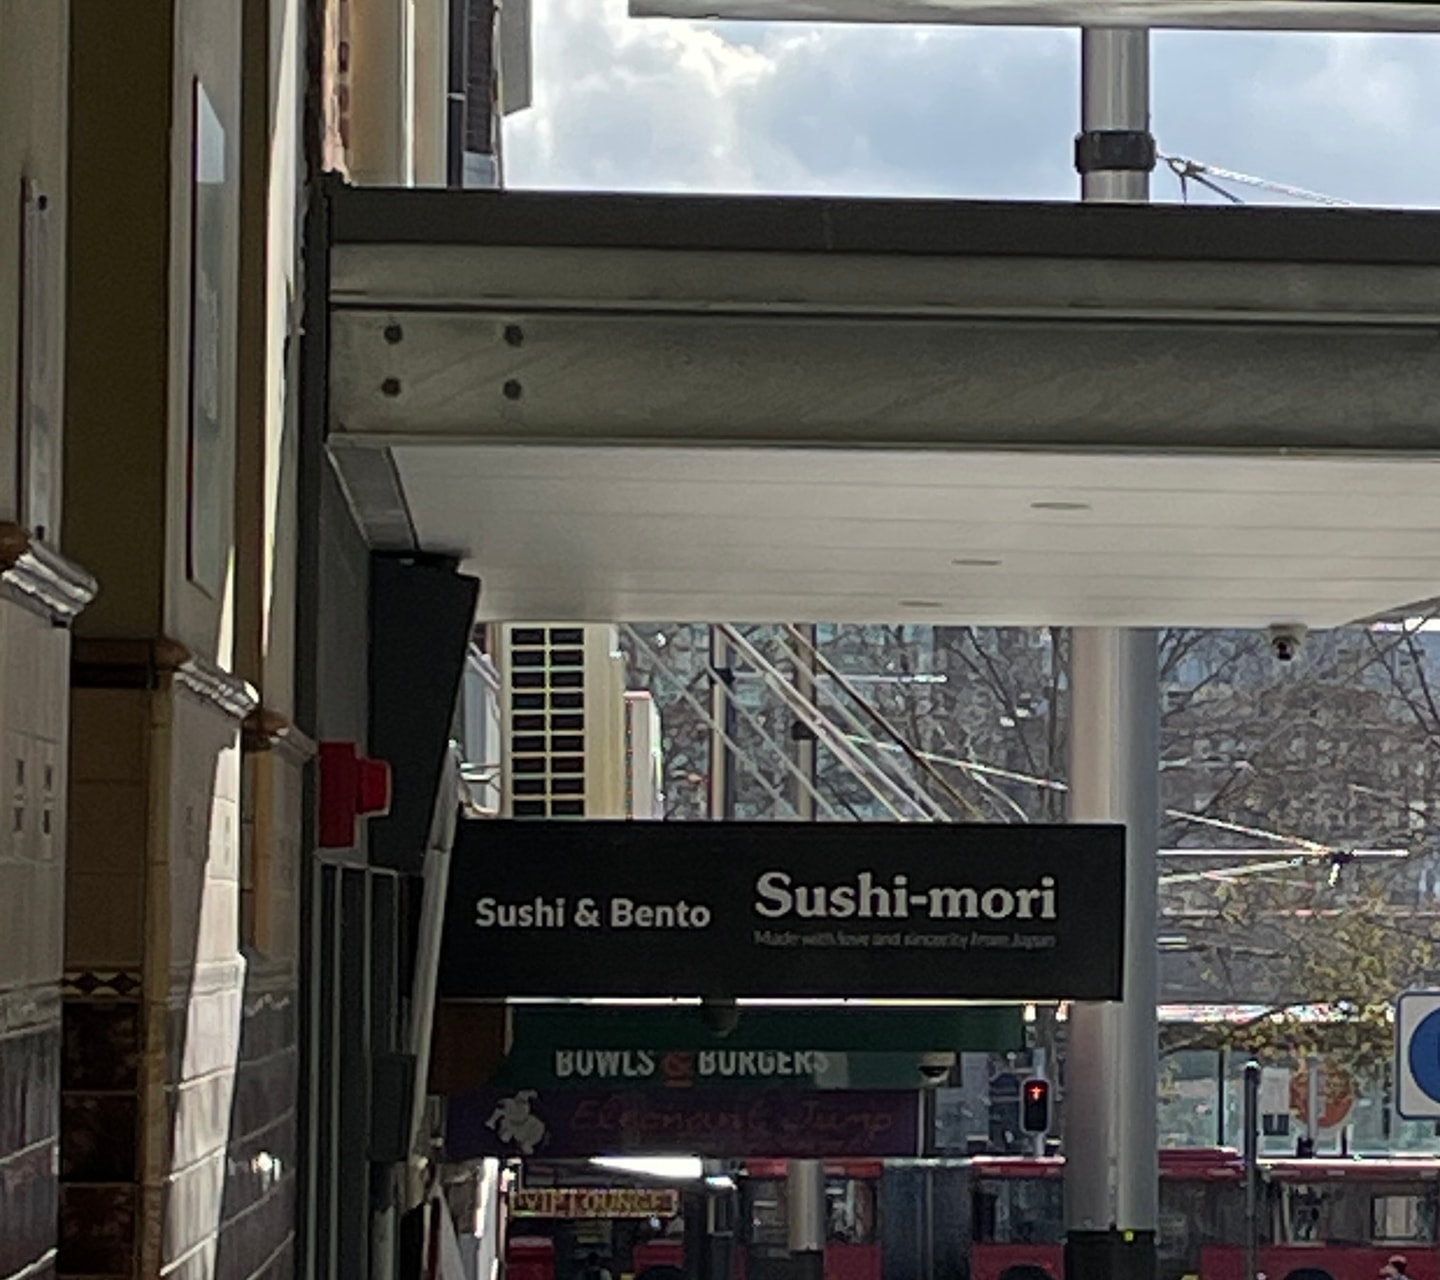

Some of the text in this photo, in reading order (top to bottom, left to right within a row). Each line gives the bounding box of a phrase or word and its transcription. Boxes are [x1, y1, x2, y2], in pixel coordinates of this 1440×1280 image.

[754, 871, 1057, 920] Sushi-mori
[475, 897, 711, 928] Sushi & Bento
[555, 1050, 656, 1077] BOWLS
[699, 1050, 830, 1076] BURGERS
